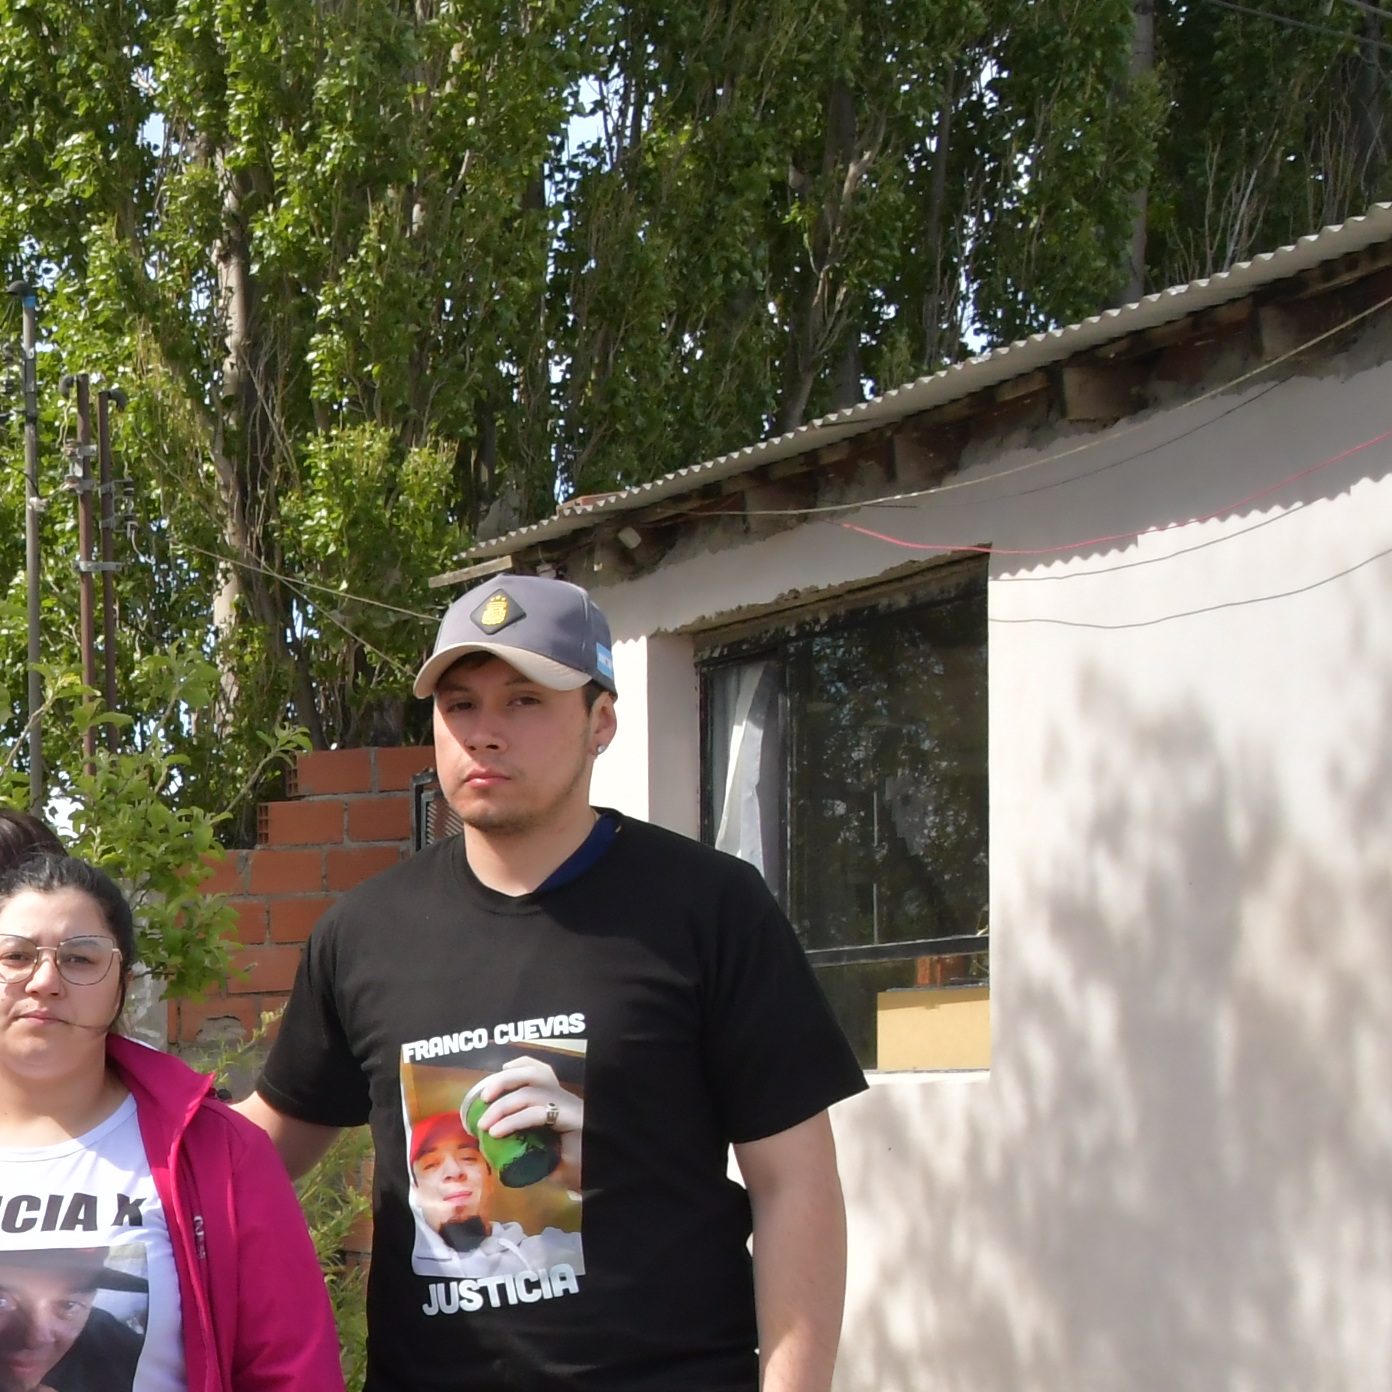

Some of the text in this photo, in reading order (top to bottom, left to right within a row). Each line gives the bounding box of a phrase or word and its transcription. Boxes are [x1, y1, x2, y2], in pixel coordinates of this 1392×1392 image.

[402, 1012, 586, 1064] FRANCO CUEVAS
[422, 1263, 580, 1316] JUSTICIA
